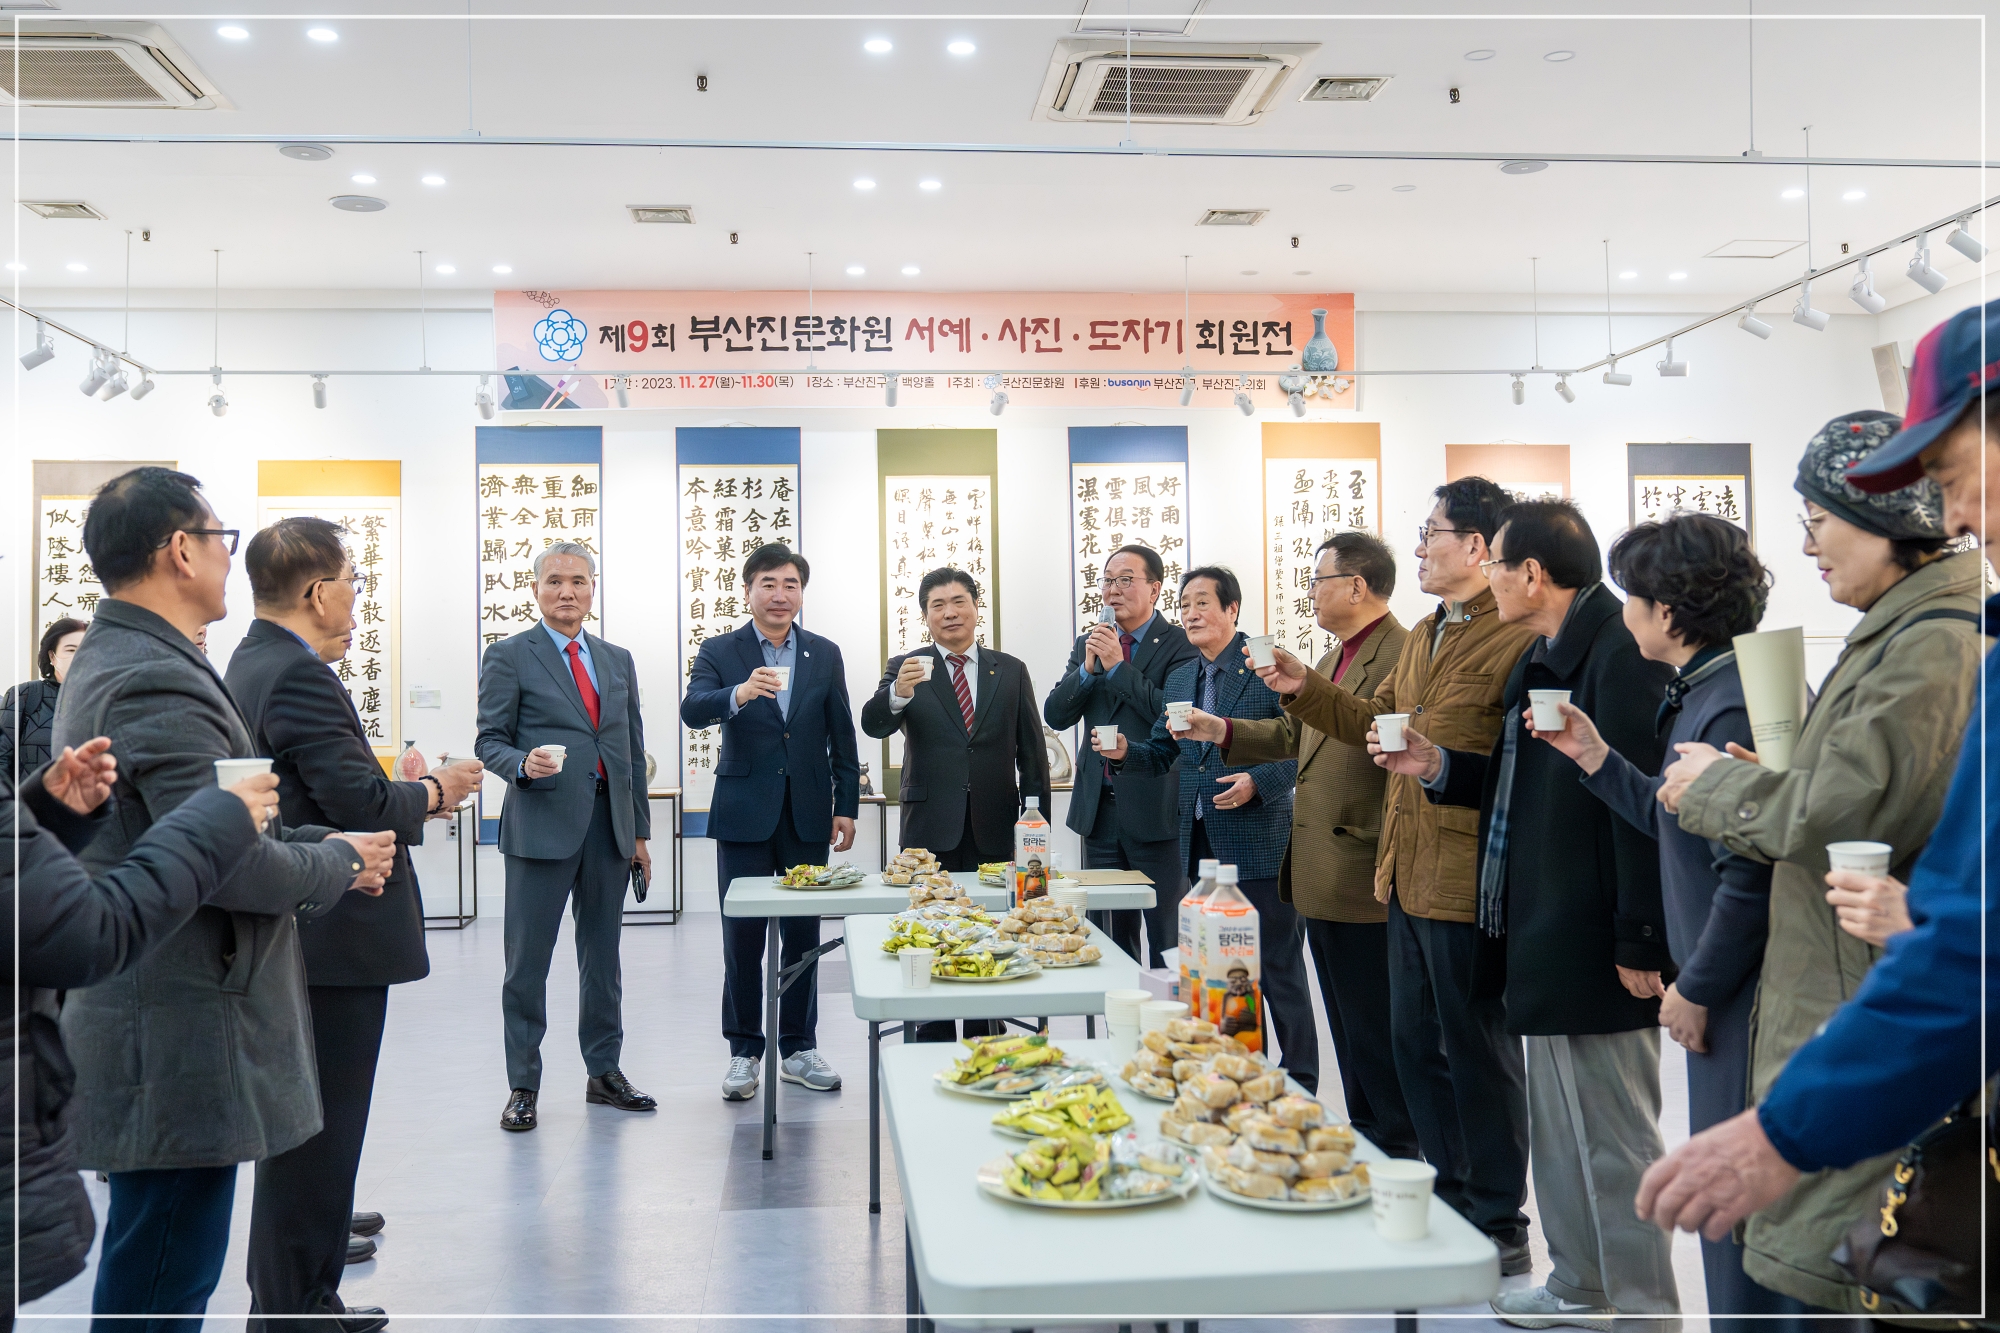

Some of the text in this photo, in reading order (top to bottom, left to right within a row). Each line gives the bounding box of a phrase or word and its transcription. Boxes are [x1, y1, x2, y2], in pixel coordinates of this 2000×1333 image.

[599, 320, 676, 352] 제9회
[688, 315, 893, 353] 부산진문화원
[1196, 319, 1294, 356] 회원전
[642, 378, 676, 389] 2023.
[812, 377, 833, 388] 장소
[843, 376, 898, 388] 부산진구
[902, 376, 935, 388] 백양홀
[952, 377, 974, 388] 주최
[1079, 377, 1100, 389] 후원
[1108, 378, 1151, 388] busanjin
[1219, 933, 1254, 946] 탐라는
